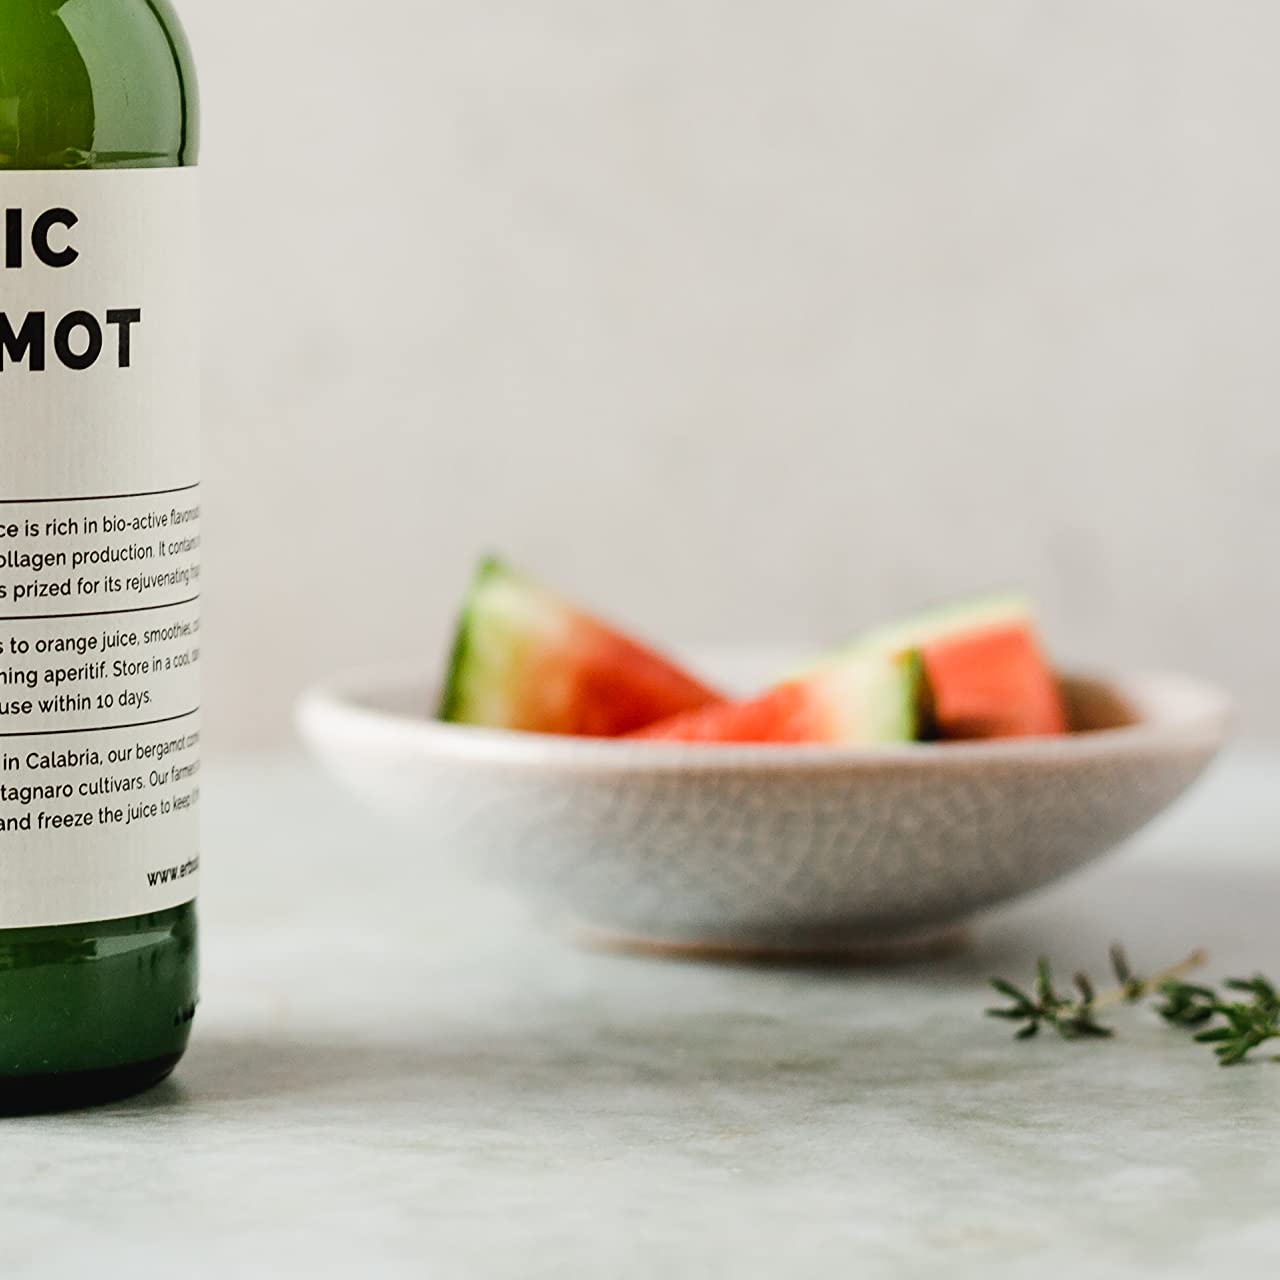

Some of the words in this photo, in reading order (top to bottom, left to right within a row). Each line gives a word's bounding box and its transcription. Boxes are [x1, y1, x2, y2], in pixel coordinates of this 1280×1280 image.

[24, 519, 40, 537] is
[46, 518, 79, 536] rich
[83, 517, 98, 534] in
[103, 512, 168, 533] bio-active
[72, 545, 156, 570] production.
[159, 541, 166, 556] It
[13, 578, 71, 602] prized
[77, 577, 100, 595] for
[104, 576, 122, 593] its
[125, 567, 190, 593] rejuvenating
[10, 637, 29, 653] to
[35, 634, 98, 657] orange
[99, 630, 140, 652] juice,
[43, 663, 108, 687] aperitif.
[113, 659, 149, 677] Store
[152, 658, 163, 671] in
[165, 658, 171, 670] a
[38, 694, 91, 713] within
[97, 694, 113, 709] 10
[118, 688, 152, 709] days.
[3, 753, 19, 771] in
[25, 748, 103, 769] Calabria,
[107, 746, 132, 763] our
[136, 737, 185, 760] bergamot
[78, 776, 146, 797] cultivars.
[149, 770, 168, 786] Our
[37, 812, 93, 829] freeze
[99, 807, 123, 824] the
[125, 803, 157, 825] juice
[160, 800, 171, 815] to
